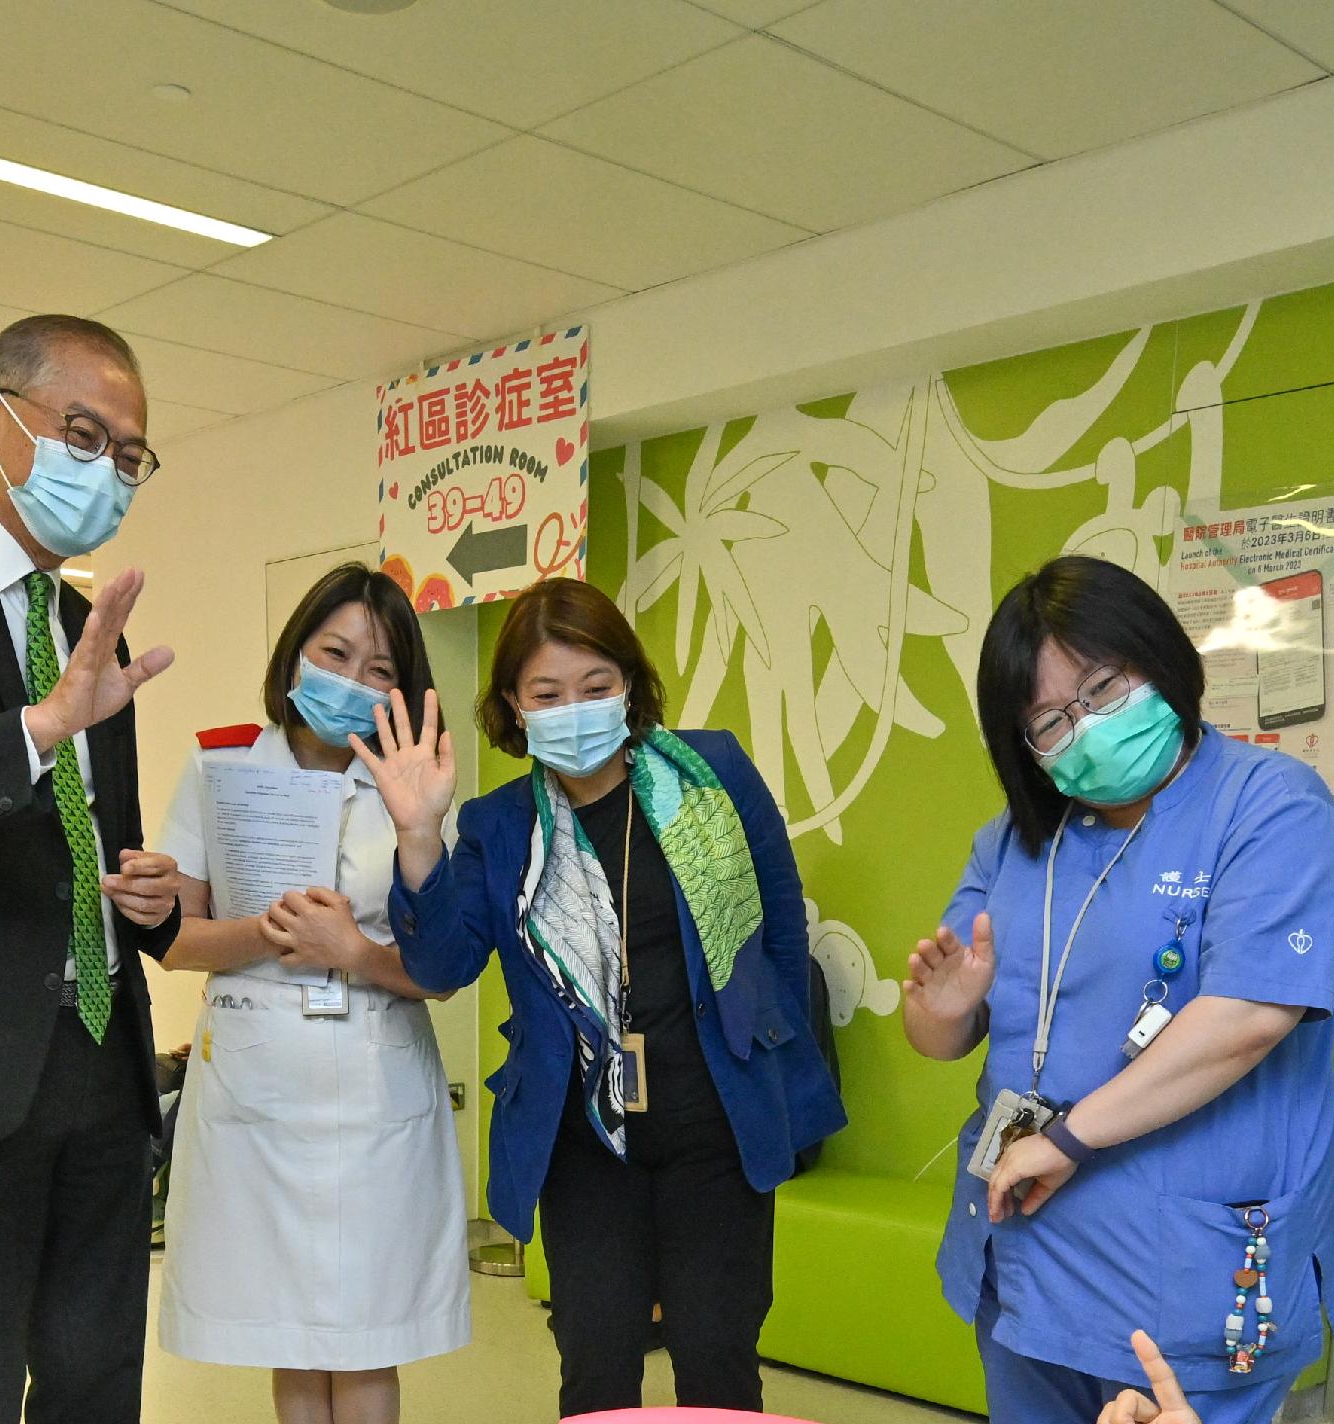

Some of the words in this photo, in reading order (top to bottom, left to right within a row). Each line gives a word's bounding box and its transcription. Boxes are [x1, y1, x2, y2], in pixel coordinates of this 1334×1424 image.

[384, 356, 578, 461] 紅區診症室
[408, 445, 505, 510] CONSULTATION
[509, 447, 548, 484] ROOM
[427, 473, 526, 534] 39-49
[1181, 549, 1203, 560] Launch
[1205, 548, 1212, 557] of
[1239, 552, 1273, 565] Electronic
[1275, 548, 1303, 561] Medical
[1263, 561, 1284, 573] March
[1158, 870, 1212, 884] 護士
[1152, 883, 1211, 899] NURSE
